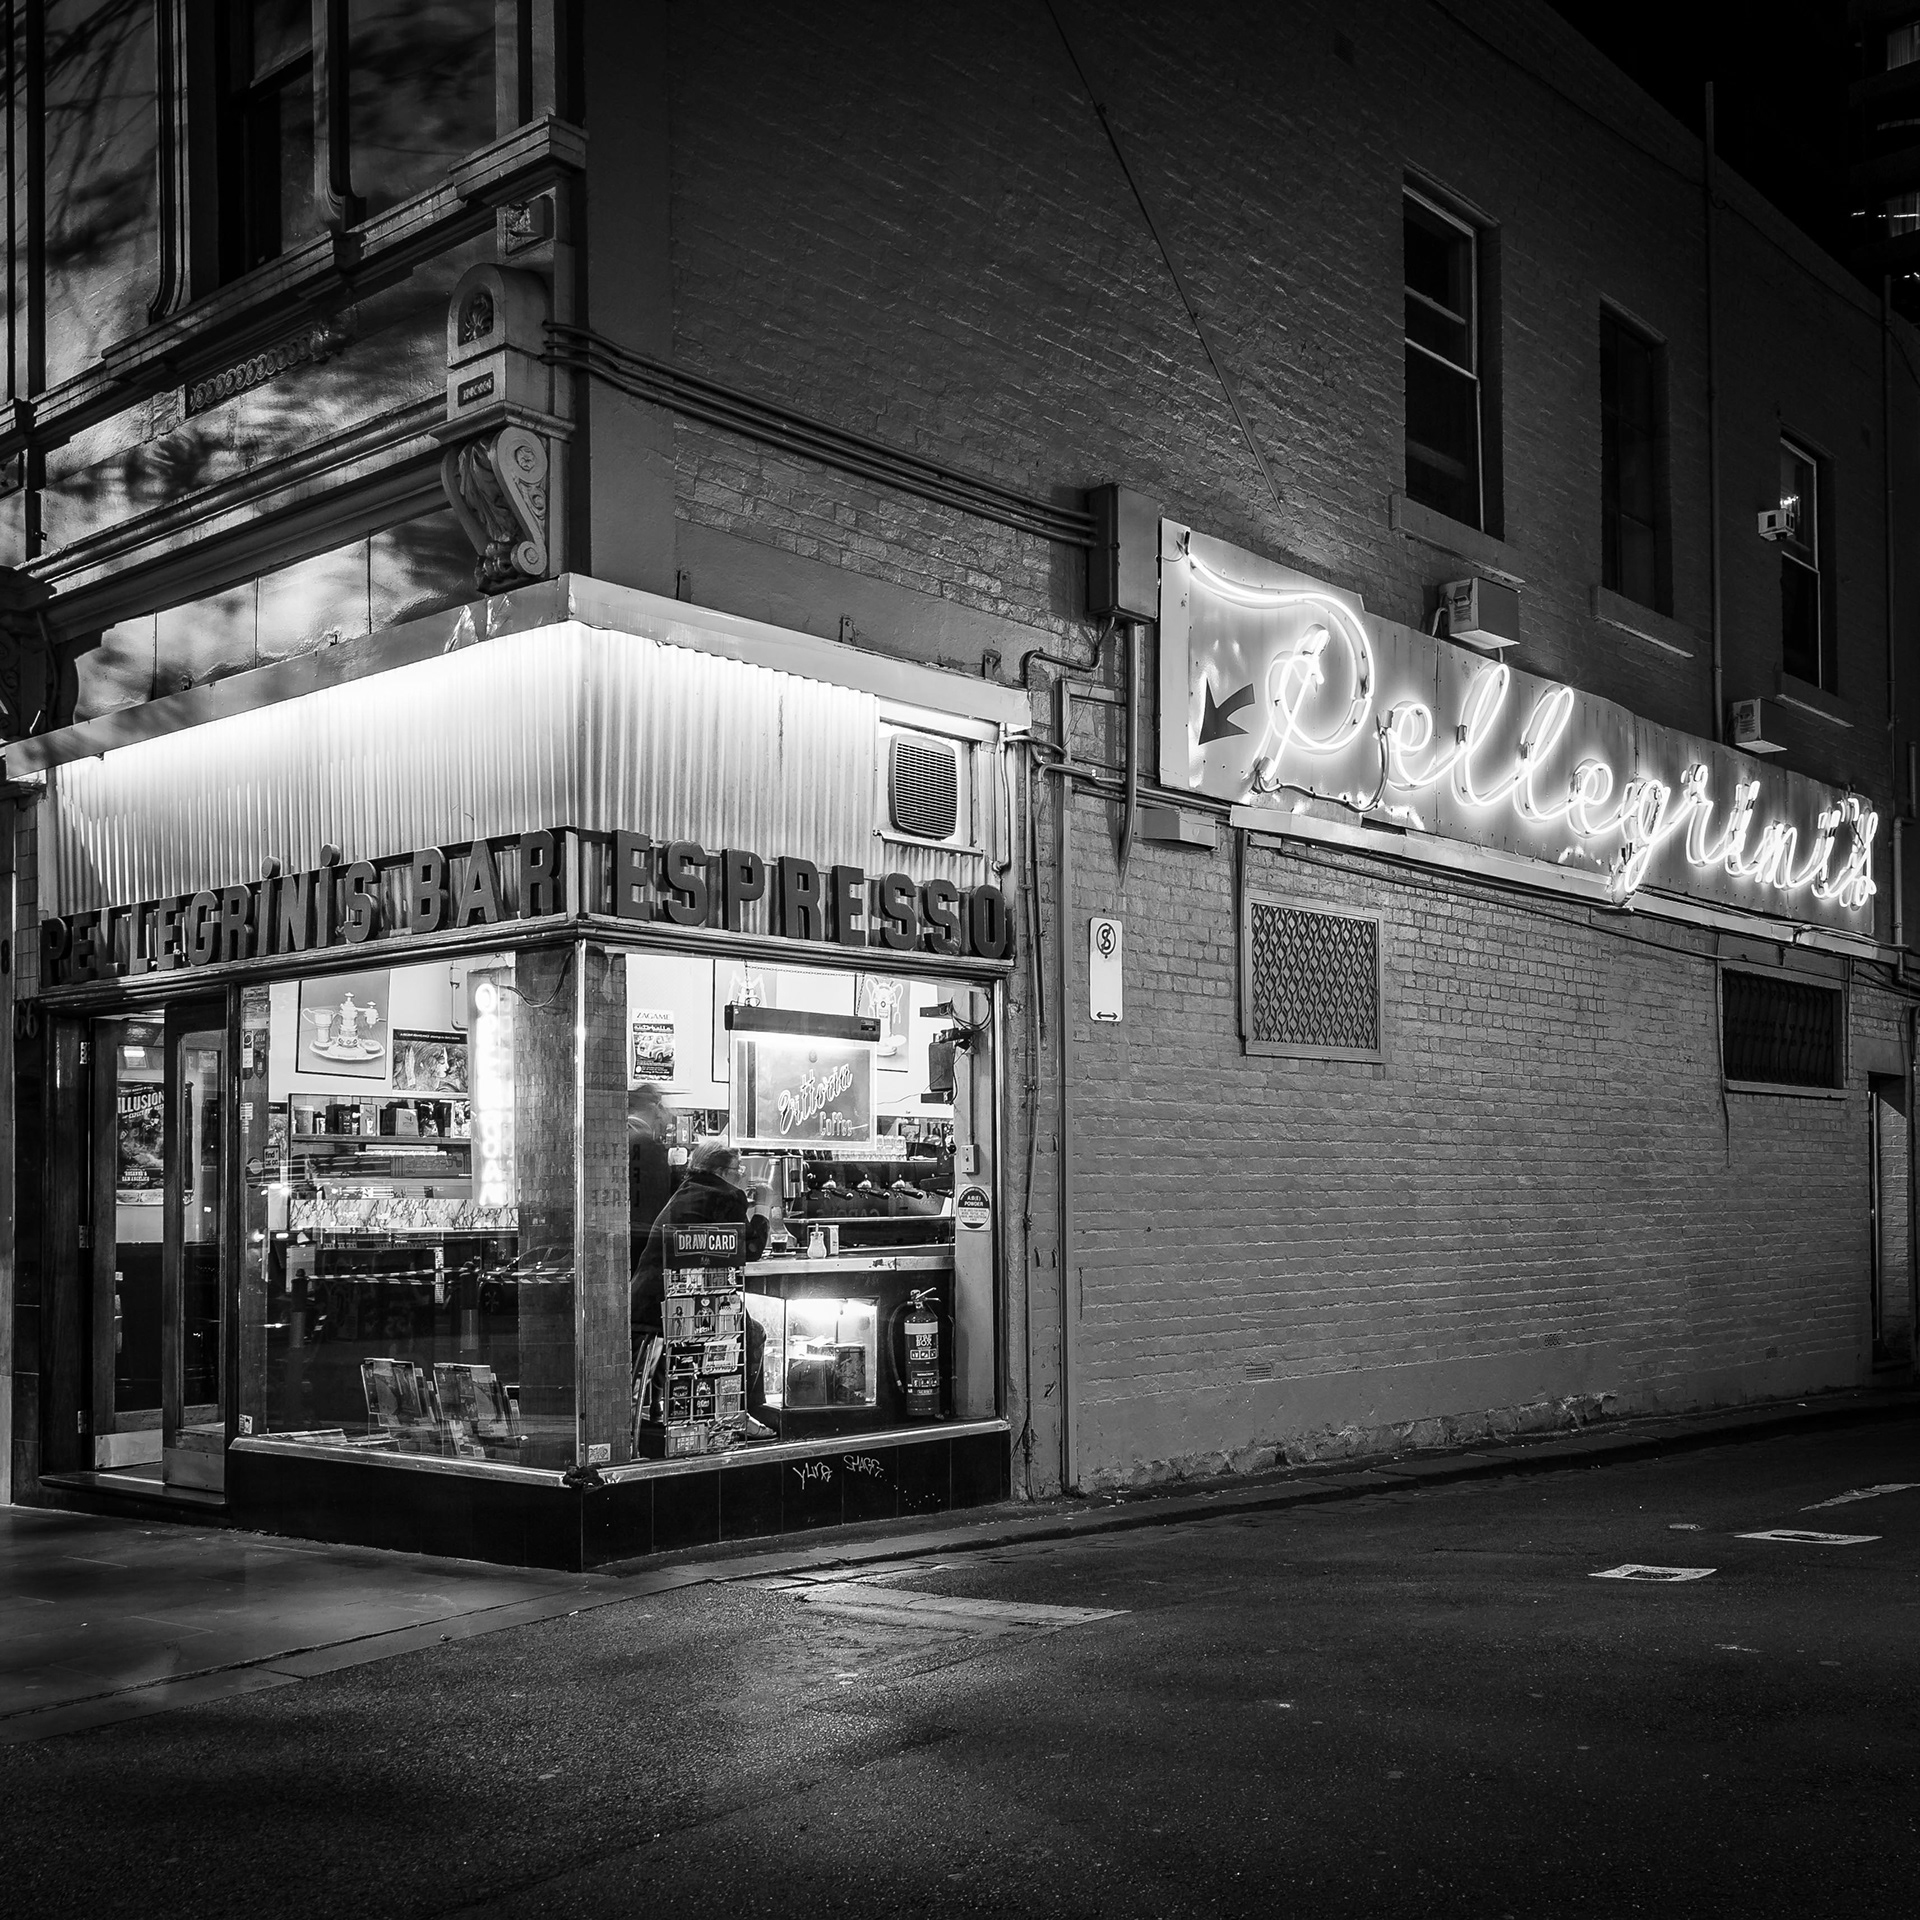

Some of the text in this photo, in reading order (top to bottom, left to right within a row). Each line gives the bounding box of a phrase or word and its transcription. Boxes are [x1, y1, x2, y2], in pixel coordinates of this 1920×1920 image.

[411, 829, 565, 935] BAR
[611, 829, 1012, 958] ESPRESSO
[15, 1000, 39, 1040] 66
[637, 1012, 669, 1020] ZAGAME
[820, 1111, 853, 1137] Coffee
[678, 1234, 736, 1250] DRAW CARD
